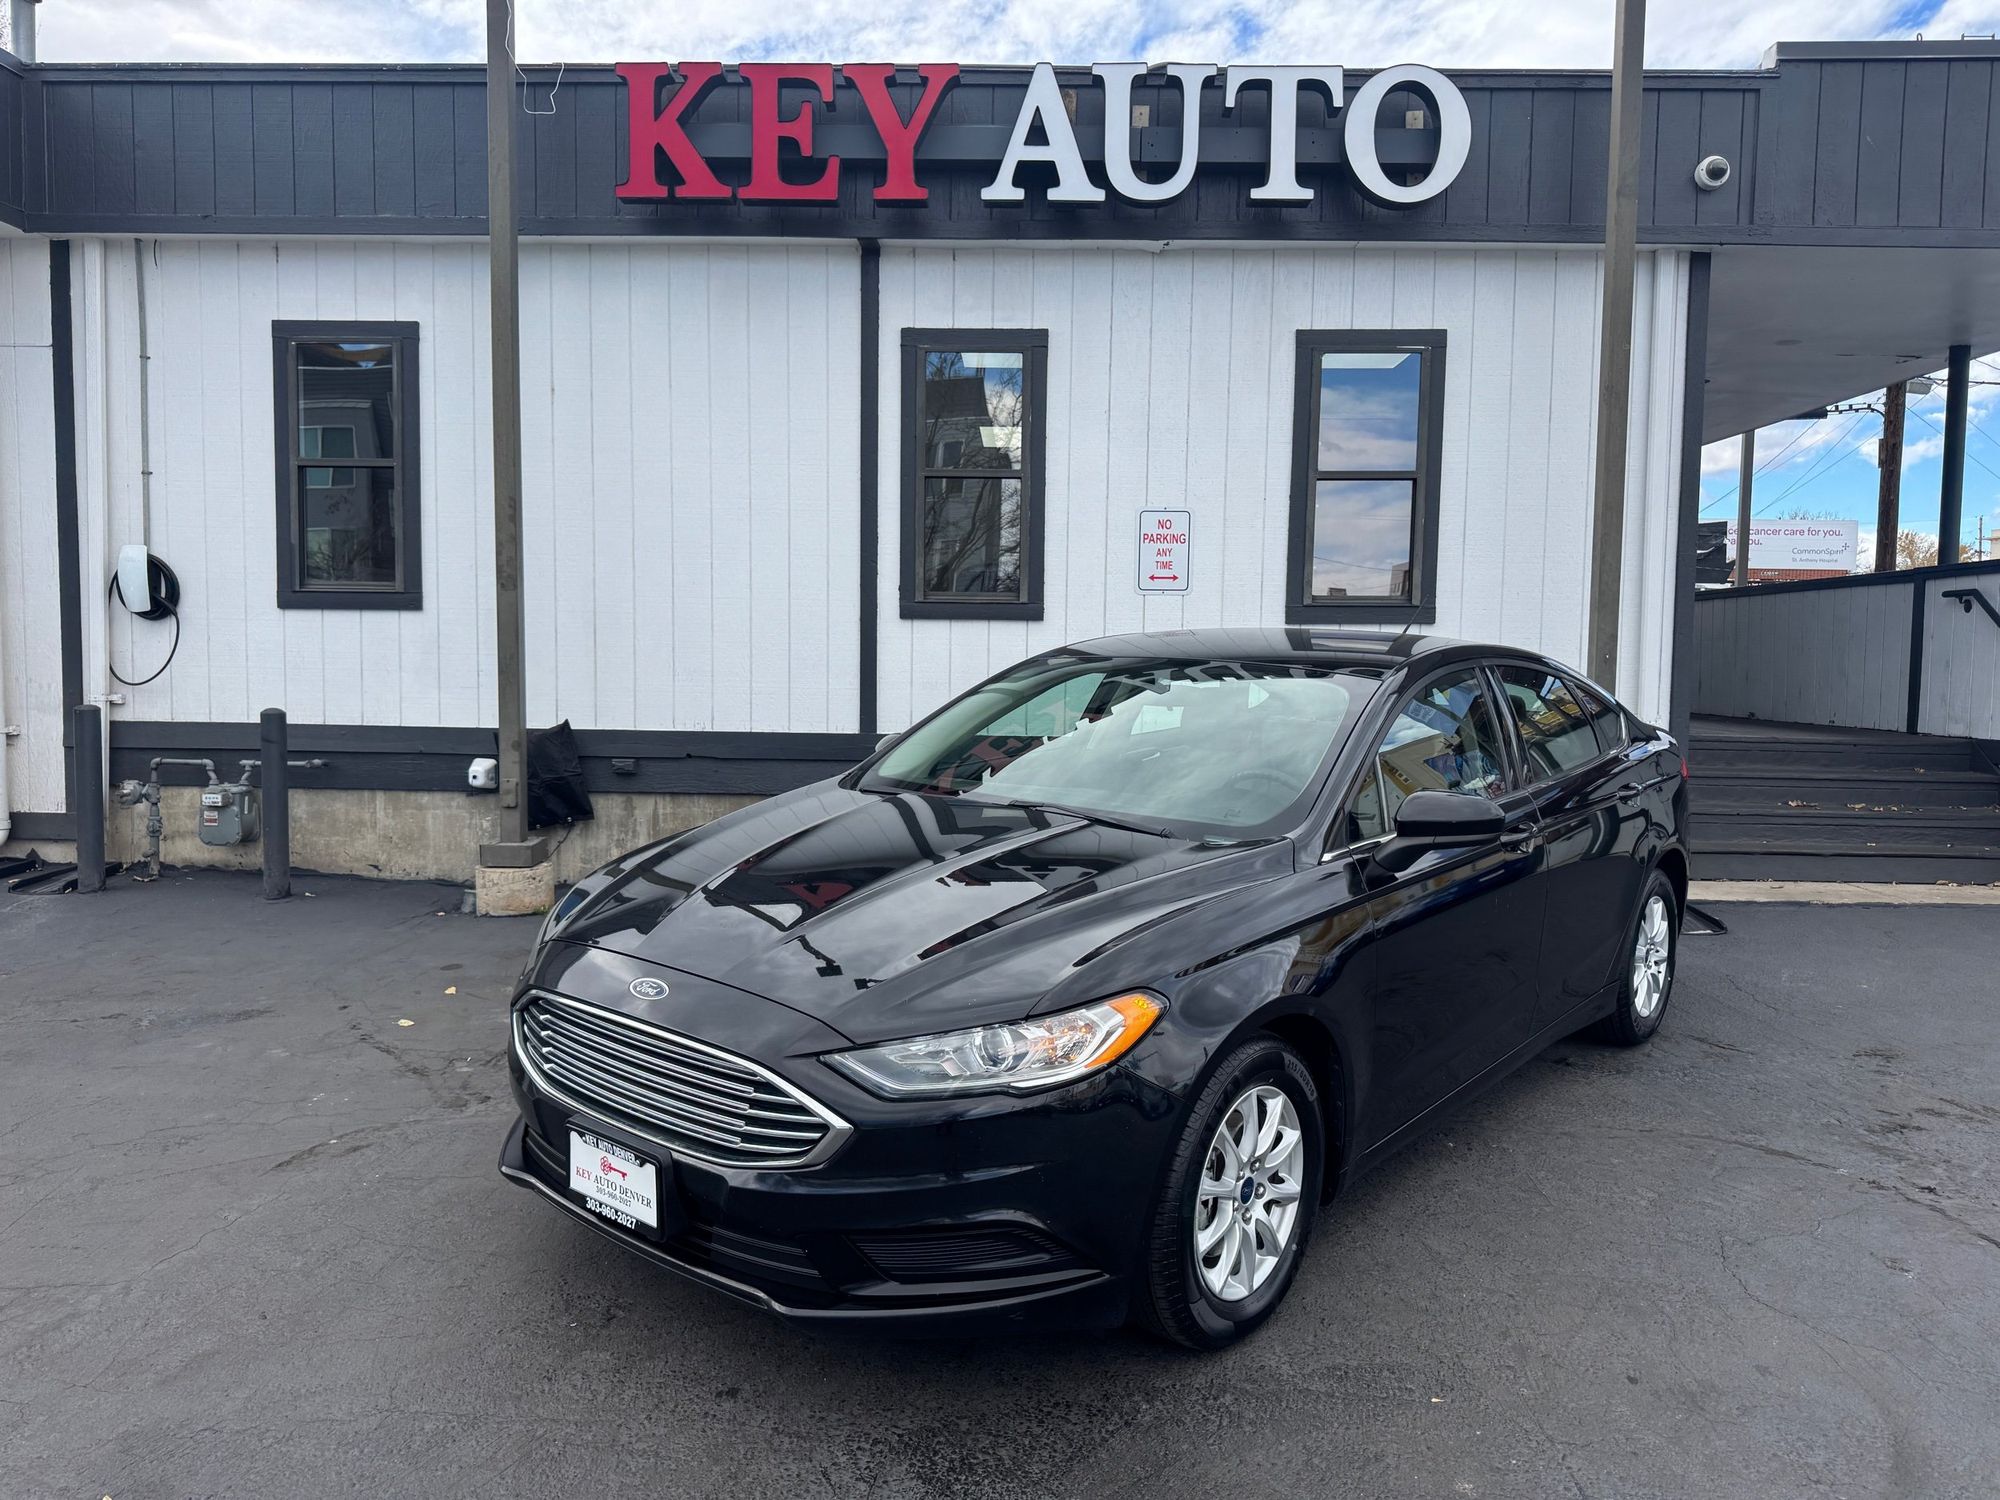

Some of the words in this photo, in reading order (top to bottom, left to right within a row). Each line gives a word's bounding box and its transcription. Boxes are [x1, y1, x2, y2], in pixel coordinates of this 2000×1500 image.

[615, 62, 960, 203] KEY
[981, 62, 1473, 204] AUTO
[1157, 519, 1172, 530] NO
[1143, 533, 1187, 544] PARKING
[1749, 528, 1781, 536] cancer
[1783, 528, 1805, 536] care
[1807, 526, 1821, 536] for
[1822, 529, 1843, 538] you.
[1156, 548, 1173, 557] ANY
[1791, 547, 1844, 556] CommonSpirit
[1155, 561, 1173, 570] TIME
[636, 981, 660, 996] Ford
[585, 1133, 598, 1148] KEY
[597, 1139, 613, 1155] AUTO
[612, 1145, 636, 1165] DENVER
[576, 1166, 592, 1180] KEY
[593, 1174, 617, 1192] AUTO
[619, 1184, 652, 1209] DENVER
[596, 1185, 632, 1208] 303-960-2027
[586, 1197, 636, 1230] 303-960-2027
